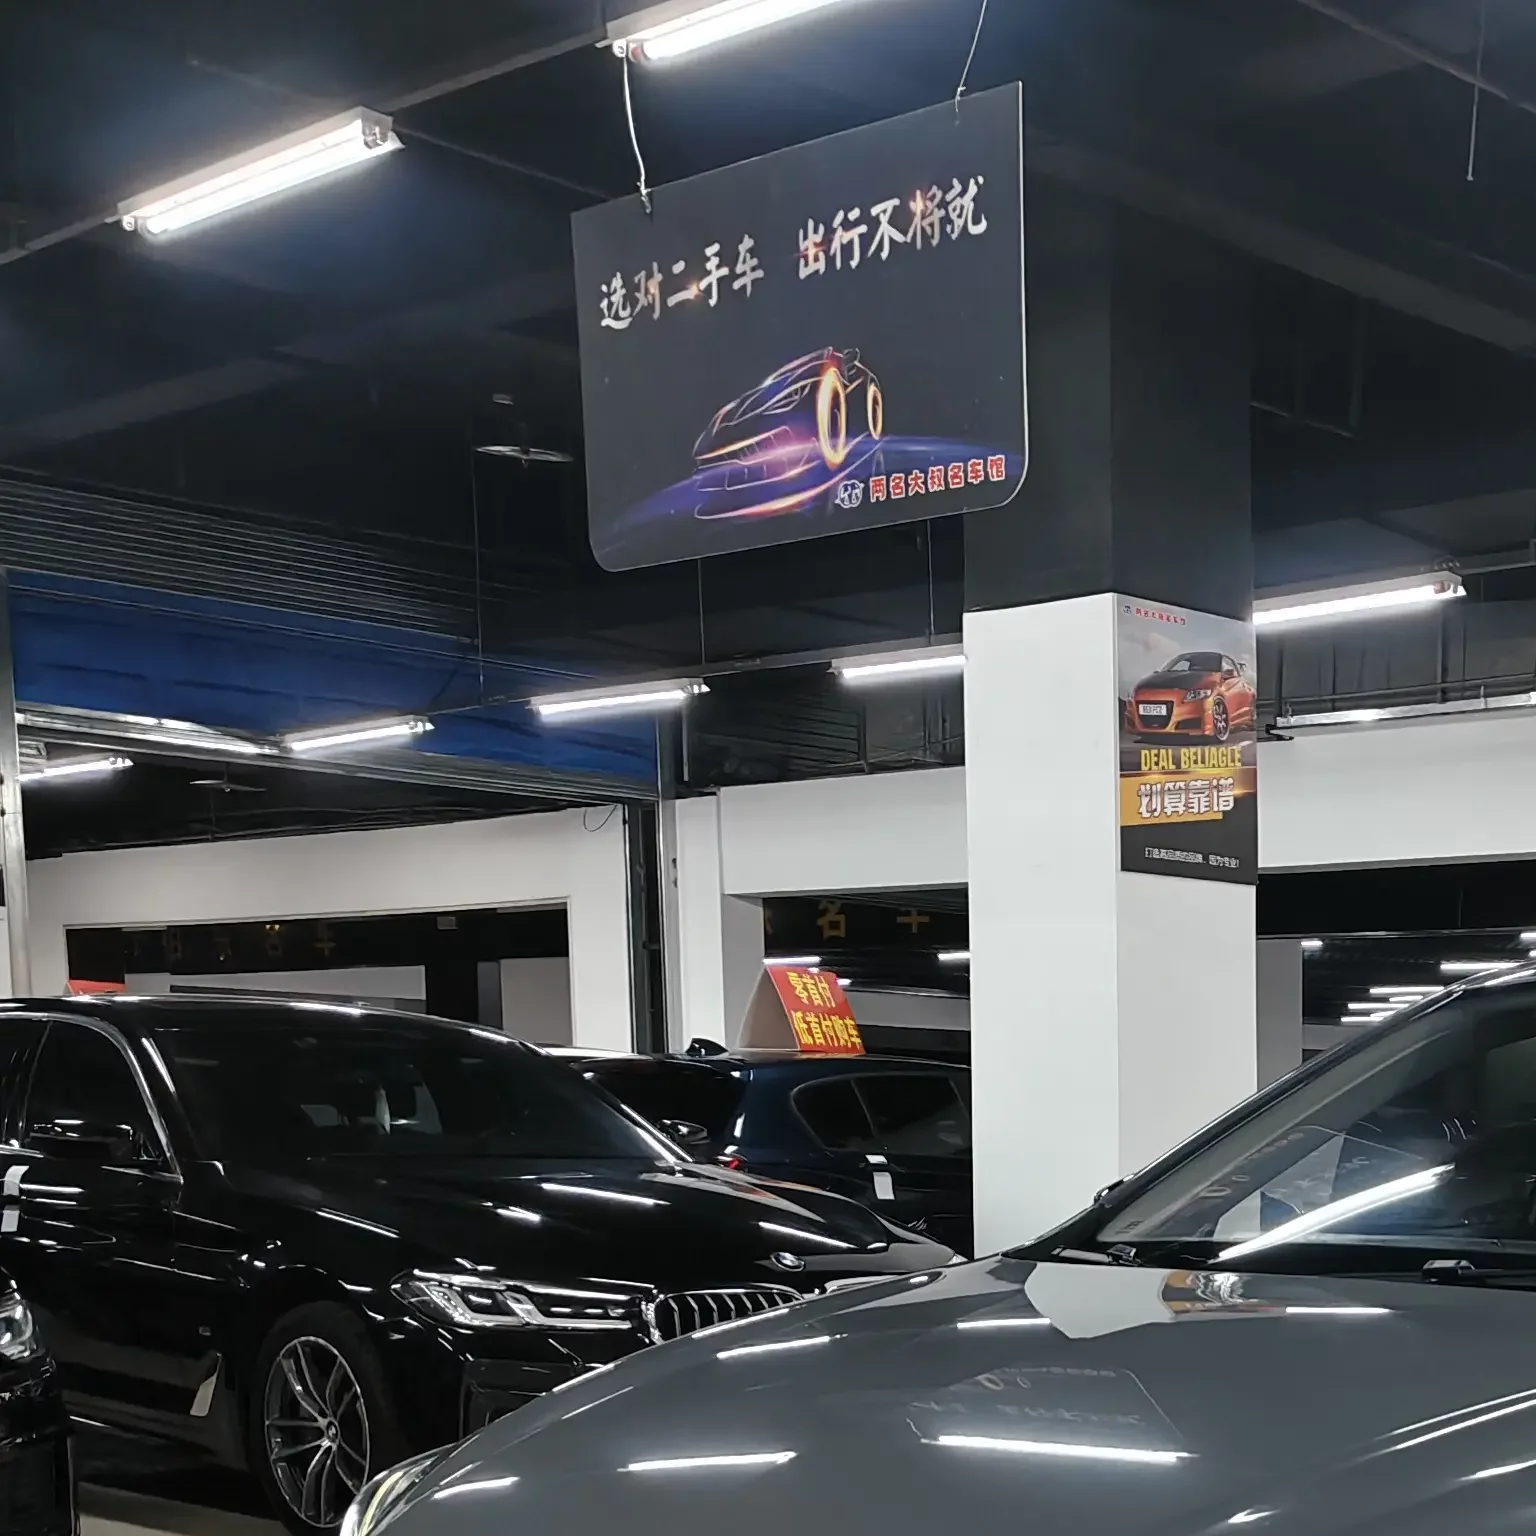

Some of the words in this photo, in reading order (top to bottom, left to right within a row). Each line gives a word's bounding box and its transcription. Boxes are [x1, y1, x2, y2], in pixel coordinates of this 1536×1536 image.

[600, 233, 765, 330] 选对二手车
[798, 174, 988, 281] 出行不将就
[869, 456, 1005, 502] 两名大叔名车馆
[1140, 749, 1177, 771] DEAL
[1137, 777, 1235, 818] 划算靠谱
[786, 971, 836, 1008] 零首付
[791, 1009, 862, 1050] 低首付购车
